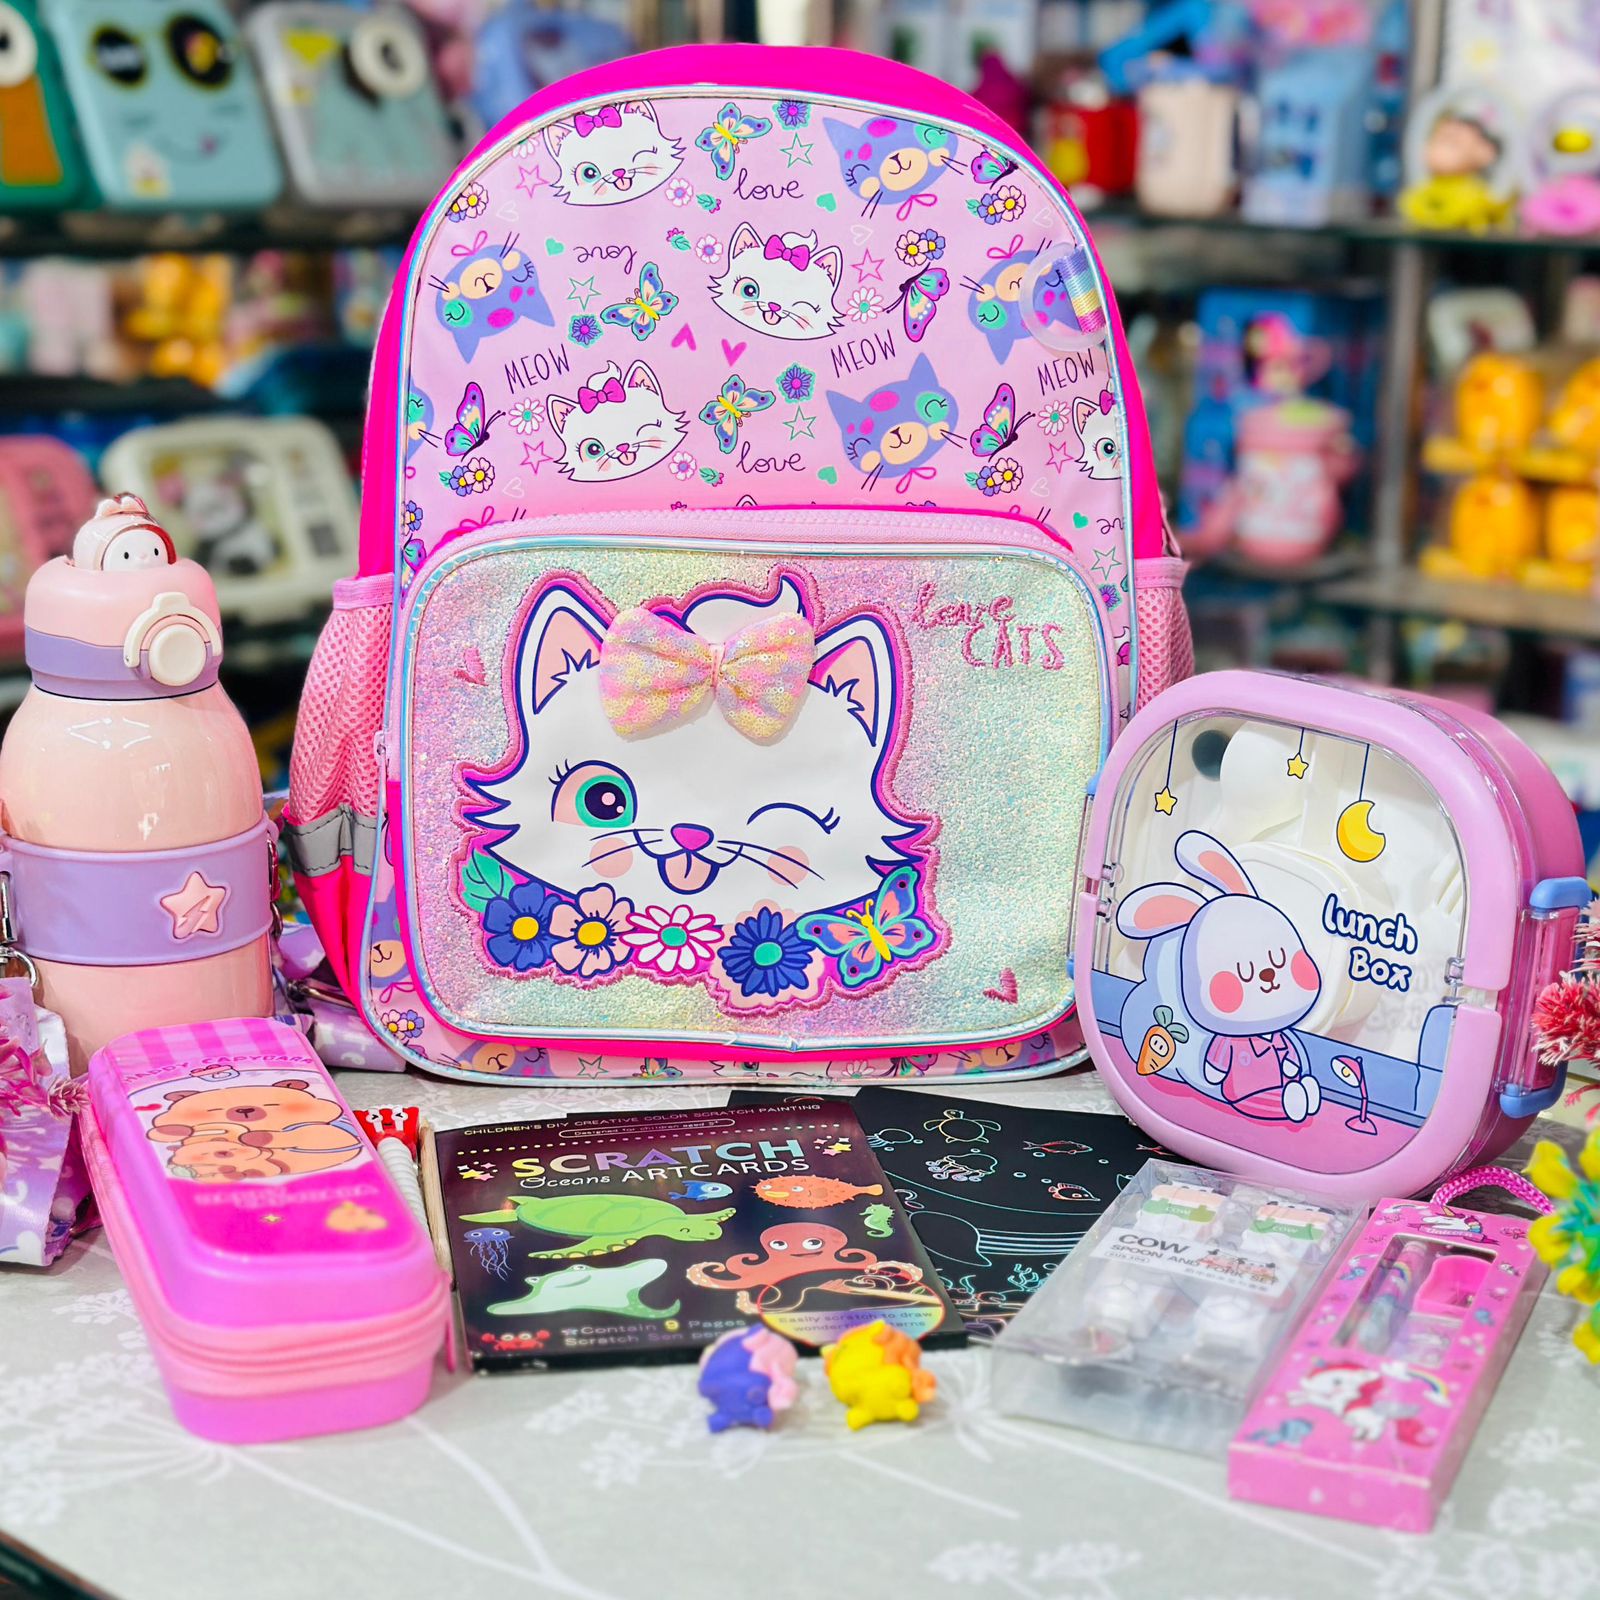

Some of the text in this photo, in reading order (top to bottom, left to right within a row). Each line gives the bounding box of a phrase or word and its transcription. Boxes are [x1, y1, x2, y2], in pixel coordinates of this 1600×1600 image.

[734, 168, 804, 200] love
[573, 244, 637, 275] love
[504, 344, 570, 395] MEOW
[830, 328, 897, 379] MEOW
[1037, 348, 1096, 397] MEOW
[736, 441, 807, 473] love
[961, 620, 1065, 671] CATS
[1322, 893, 1418, 955] lunch
[1349, 946, 1413, 993] Box
[463, 1104, 821, 1136] CHILDREN'S DIY CREATIVE COLOR SCRATCH PAINTING
[511, 1139, 806, 1179] SCRATCH
[519, 1158, 811, 1190] Oceans ARTCARDS
[1110, 1244, 1164, 1259] SPOON
[1167, 1255, 1201, 1267] AND
[1118, 1234, 1190, 1254] COW
[580, 1322, 658, 1335] Contain
[824, 1312, 878, 1322] scratch
[901, 1311, 933, 1319] draw
[564, 1335, 640, 1347] Scratch
